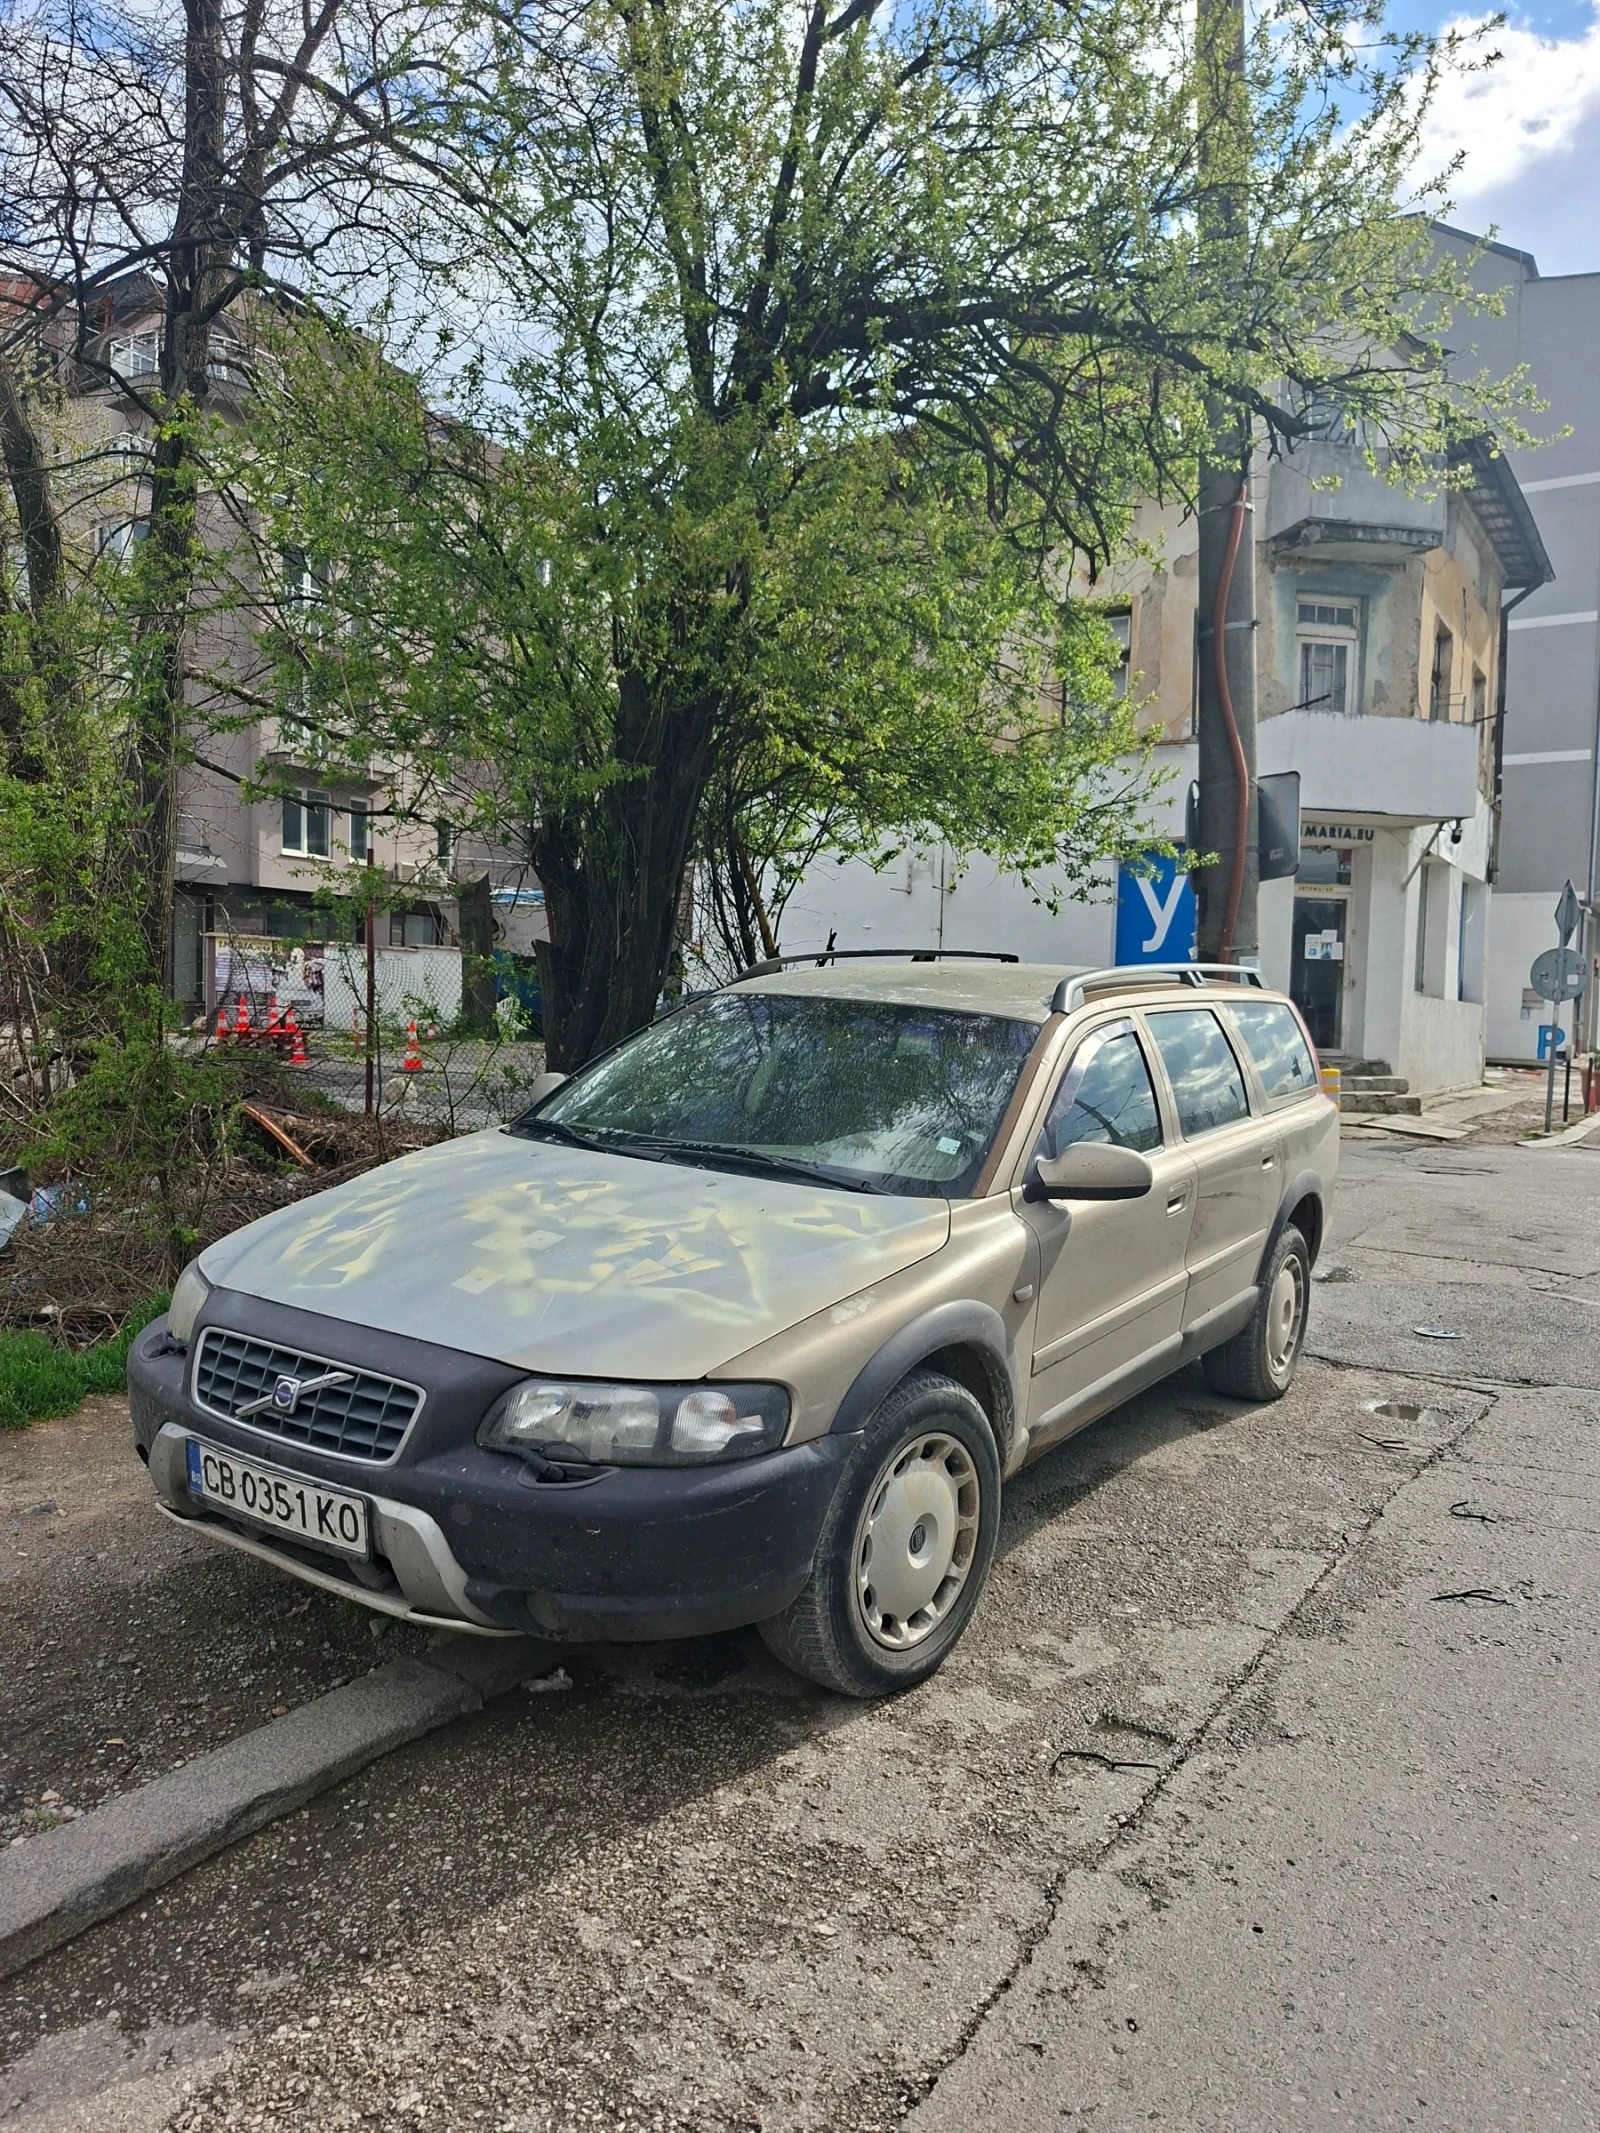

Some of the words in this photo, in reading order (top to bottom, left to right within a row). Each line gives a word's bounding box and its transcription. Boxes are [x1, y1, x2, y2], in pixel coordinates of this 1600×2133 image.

[1537, 1025, 1565, 1060] P
[191, 1470, 201, 1484] BG
[203, 1454, 236, 1500] CB
[242, 1470, 307, 1529] 0351
